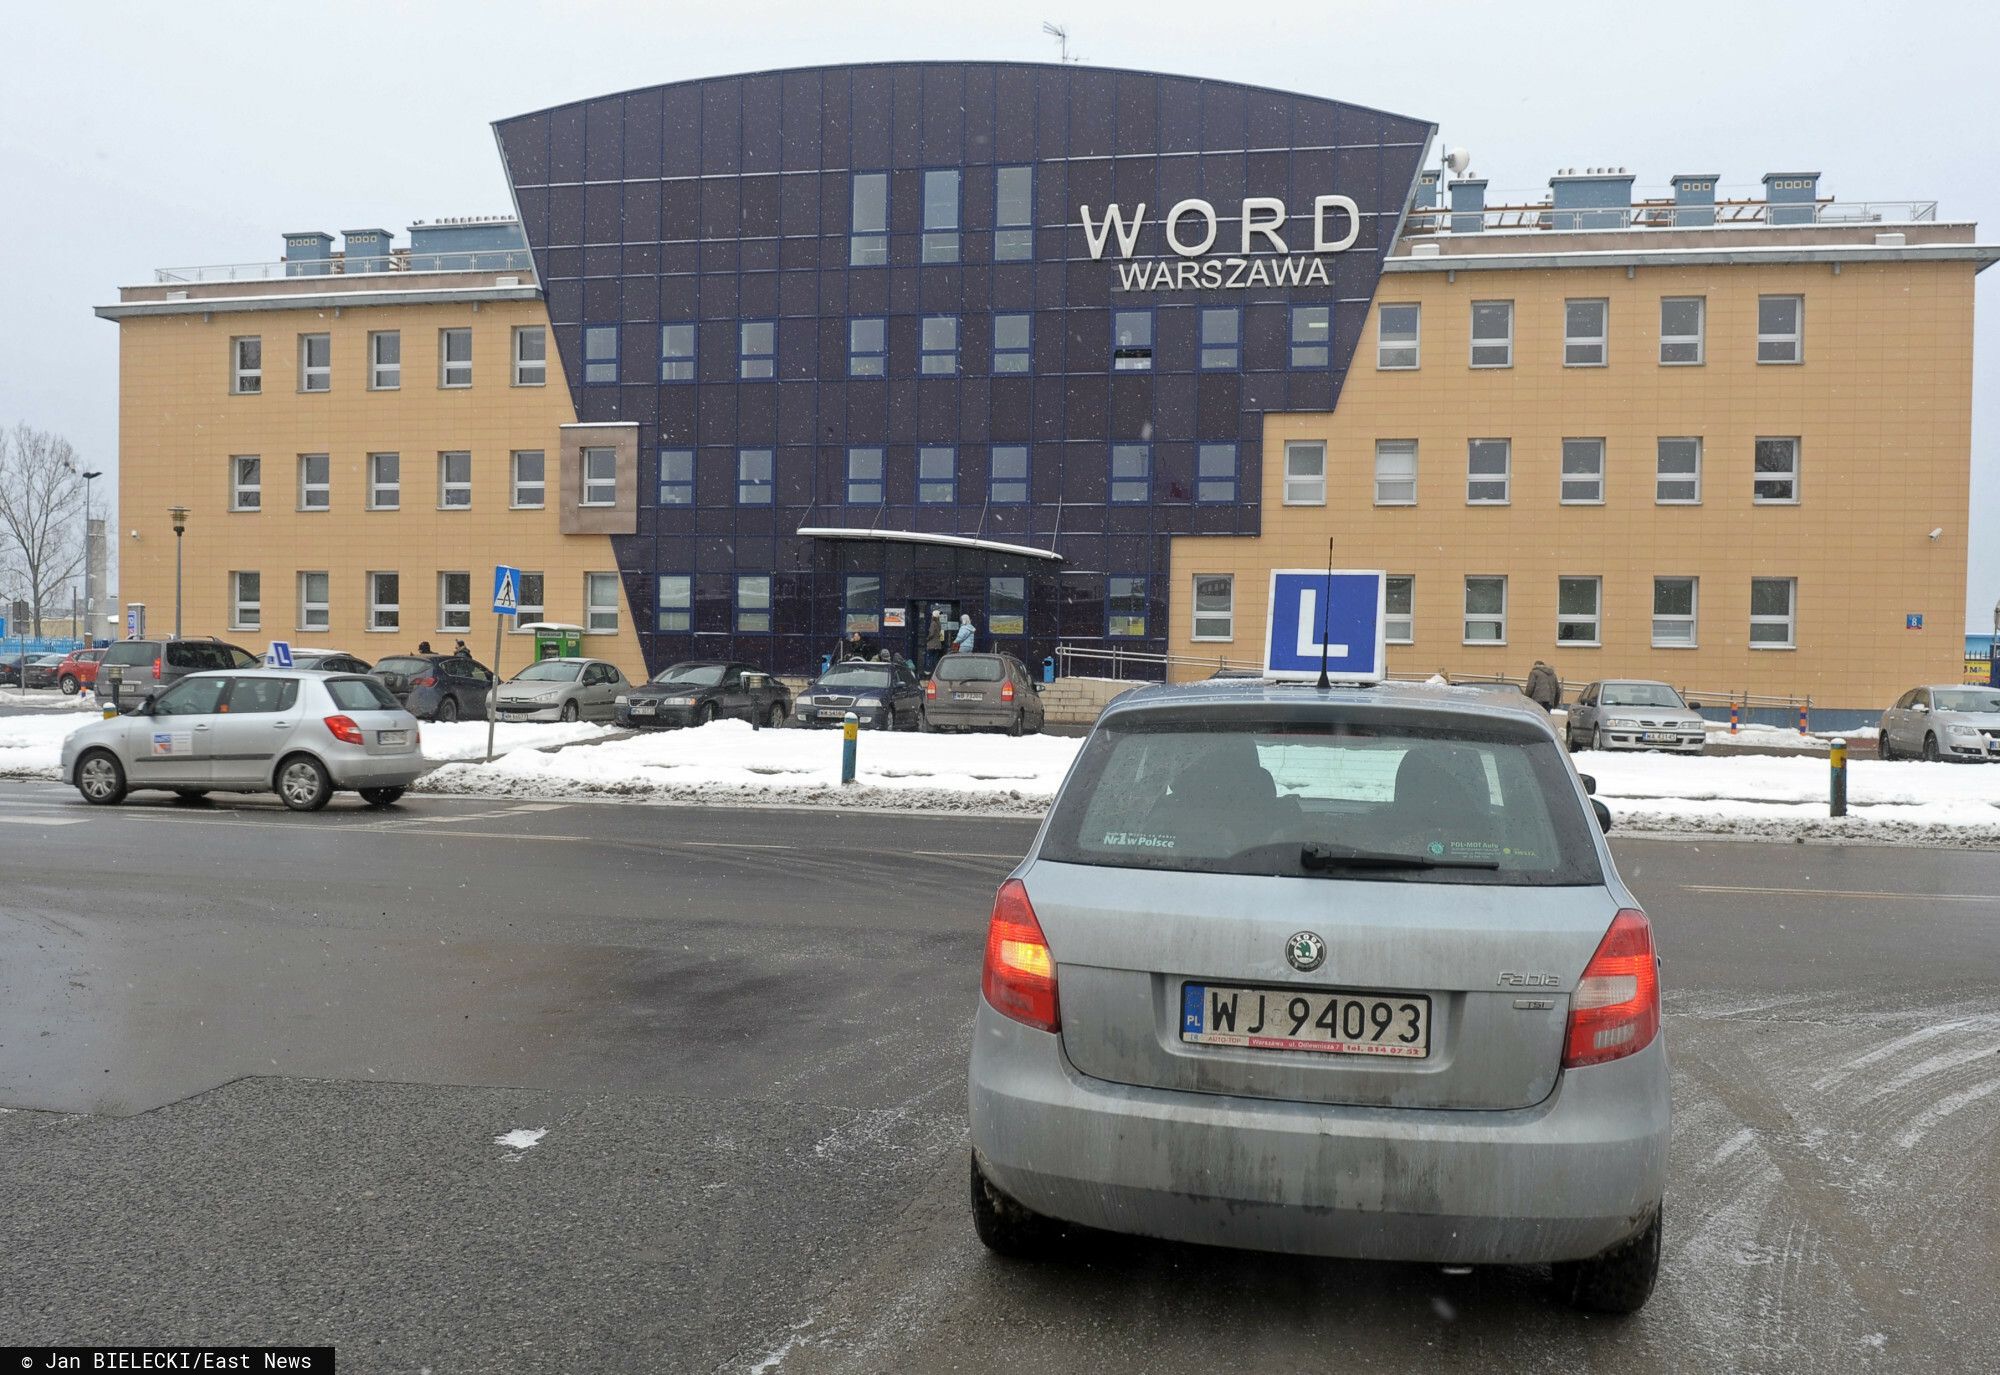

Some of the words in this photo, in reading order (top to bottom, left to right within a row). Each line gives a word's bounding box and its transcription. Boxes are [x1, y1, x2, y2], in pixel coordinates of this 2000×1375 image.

[1080, 194, 1360, 260] WORD
[1118, 256, 1330, 291] WARSZAWA
[1297, 588, 1349, 658] L
[1911, 617, 1918, 627] 8
[277, 646, 291, 664] L
[1138, 836, 1175, 848] Polsce
[1186, 1015, 1201, 1027] PL
[1288, 997, 1421, 1043] 94093
[1252, 1039, 1284, 1047] Warszawa
[1347, 1044, 1364, 1052] tel.
